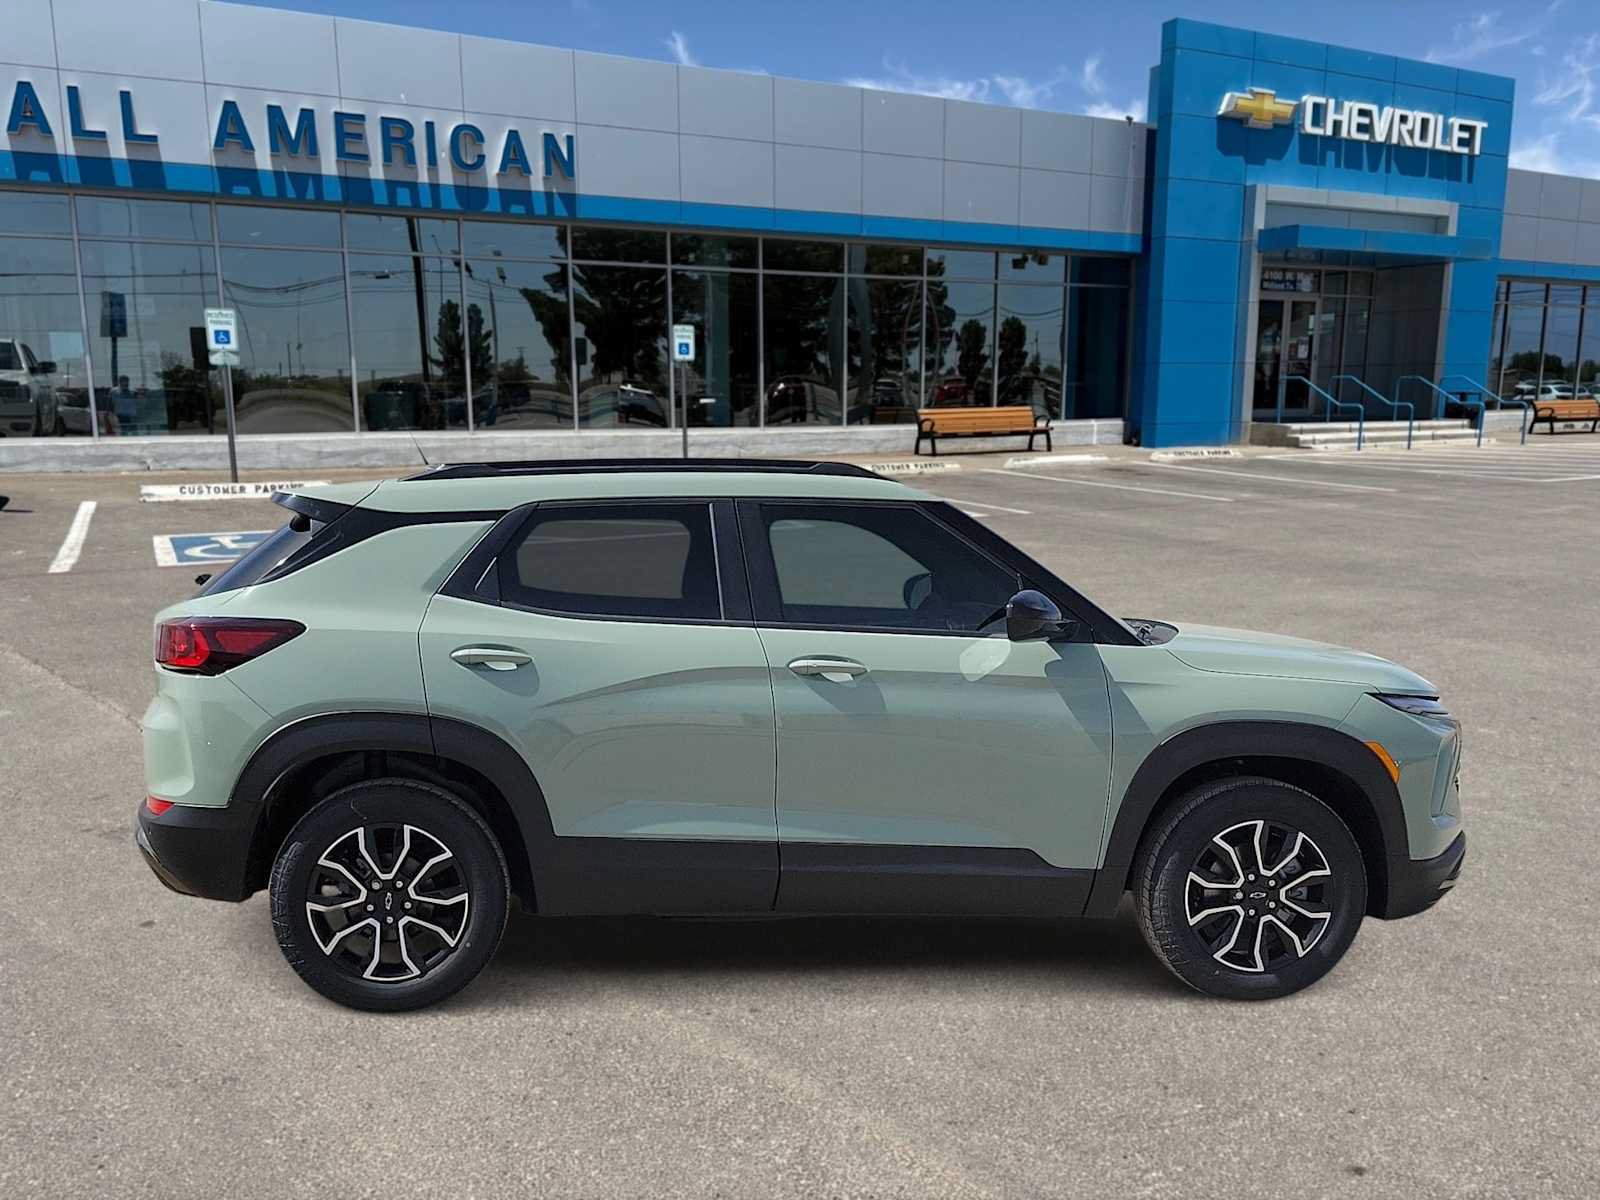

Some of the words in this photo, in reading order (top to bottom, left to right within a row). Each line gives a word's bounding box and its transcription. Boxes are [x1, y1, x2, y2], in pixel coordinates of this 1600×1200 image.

[6, 81, 158, 143] ALL
[214, 100, 576, 178] AMERICAN
[1301, 94, 1488, 155] CHEVROLET
[179, 485, 246, 494] CUSTOMER
